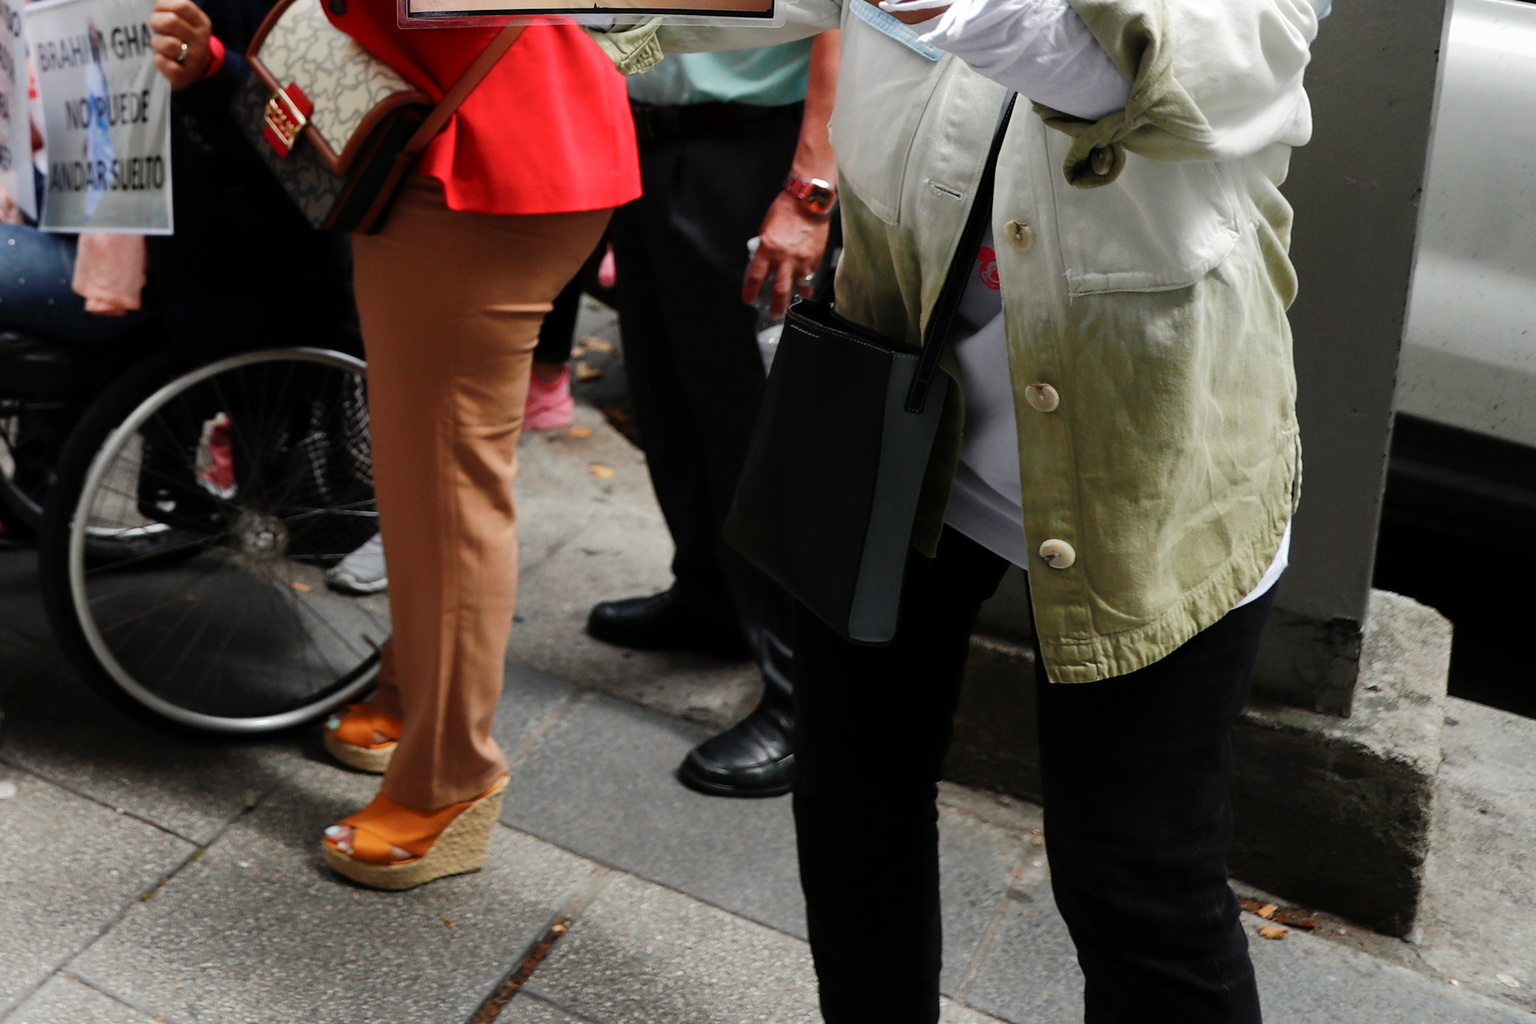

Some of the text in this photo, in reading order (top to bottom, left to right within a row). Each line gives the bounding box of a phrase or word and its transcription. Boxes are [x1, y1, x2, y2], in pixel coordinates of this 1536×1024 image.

[111, 21, 152, 61] GHA
[65, 88, 150, 130] NO PUEDE
[110, 154, 165, 193] SUELTO
